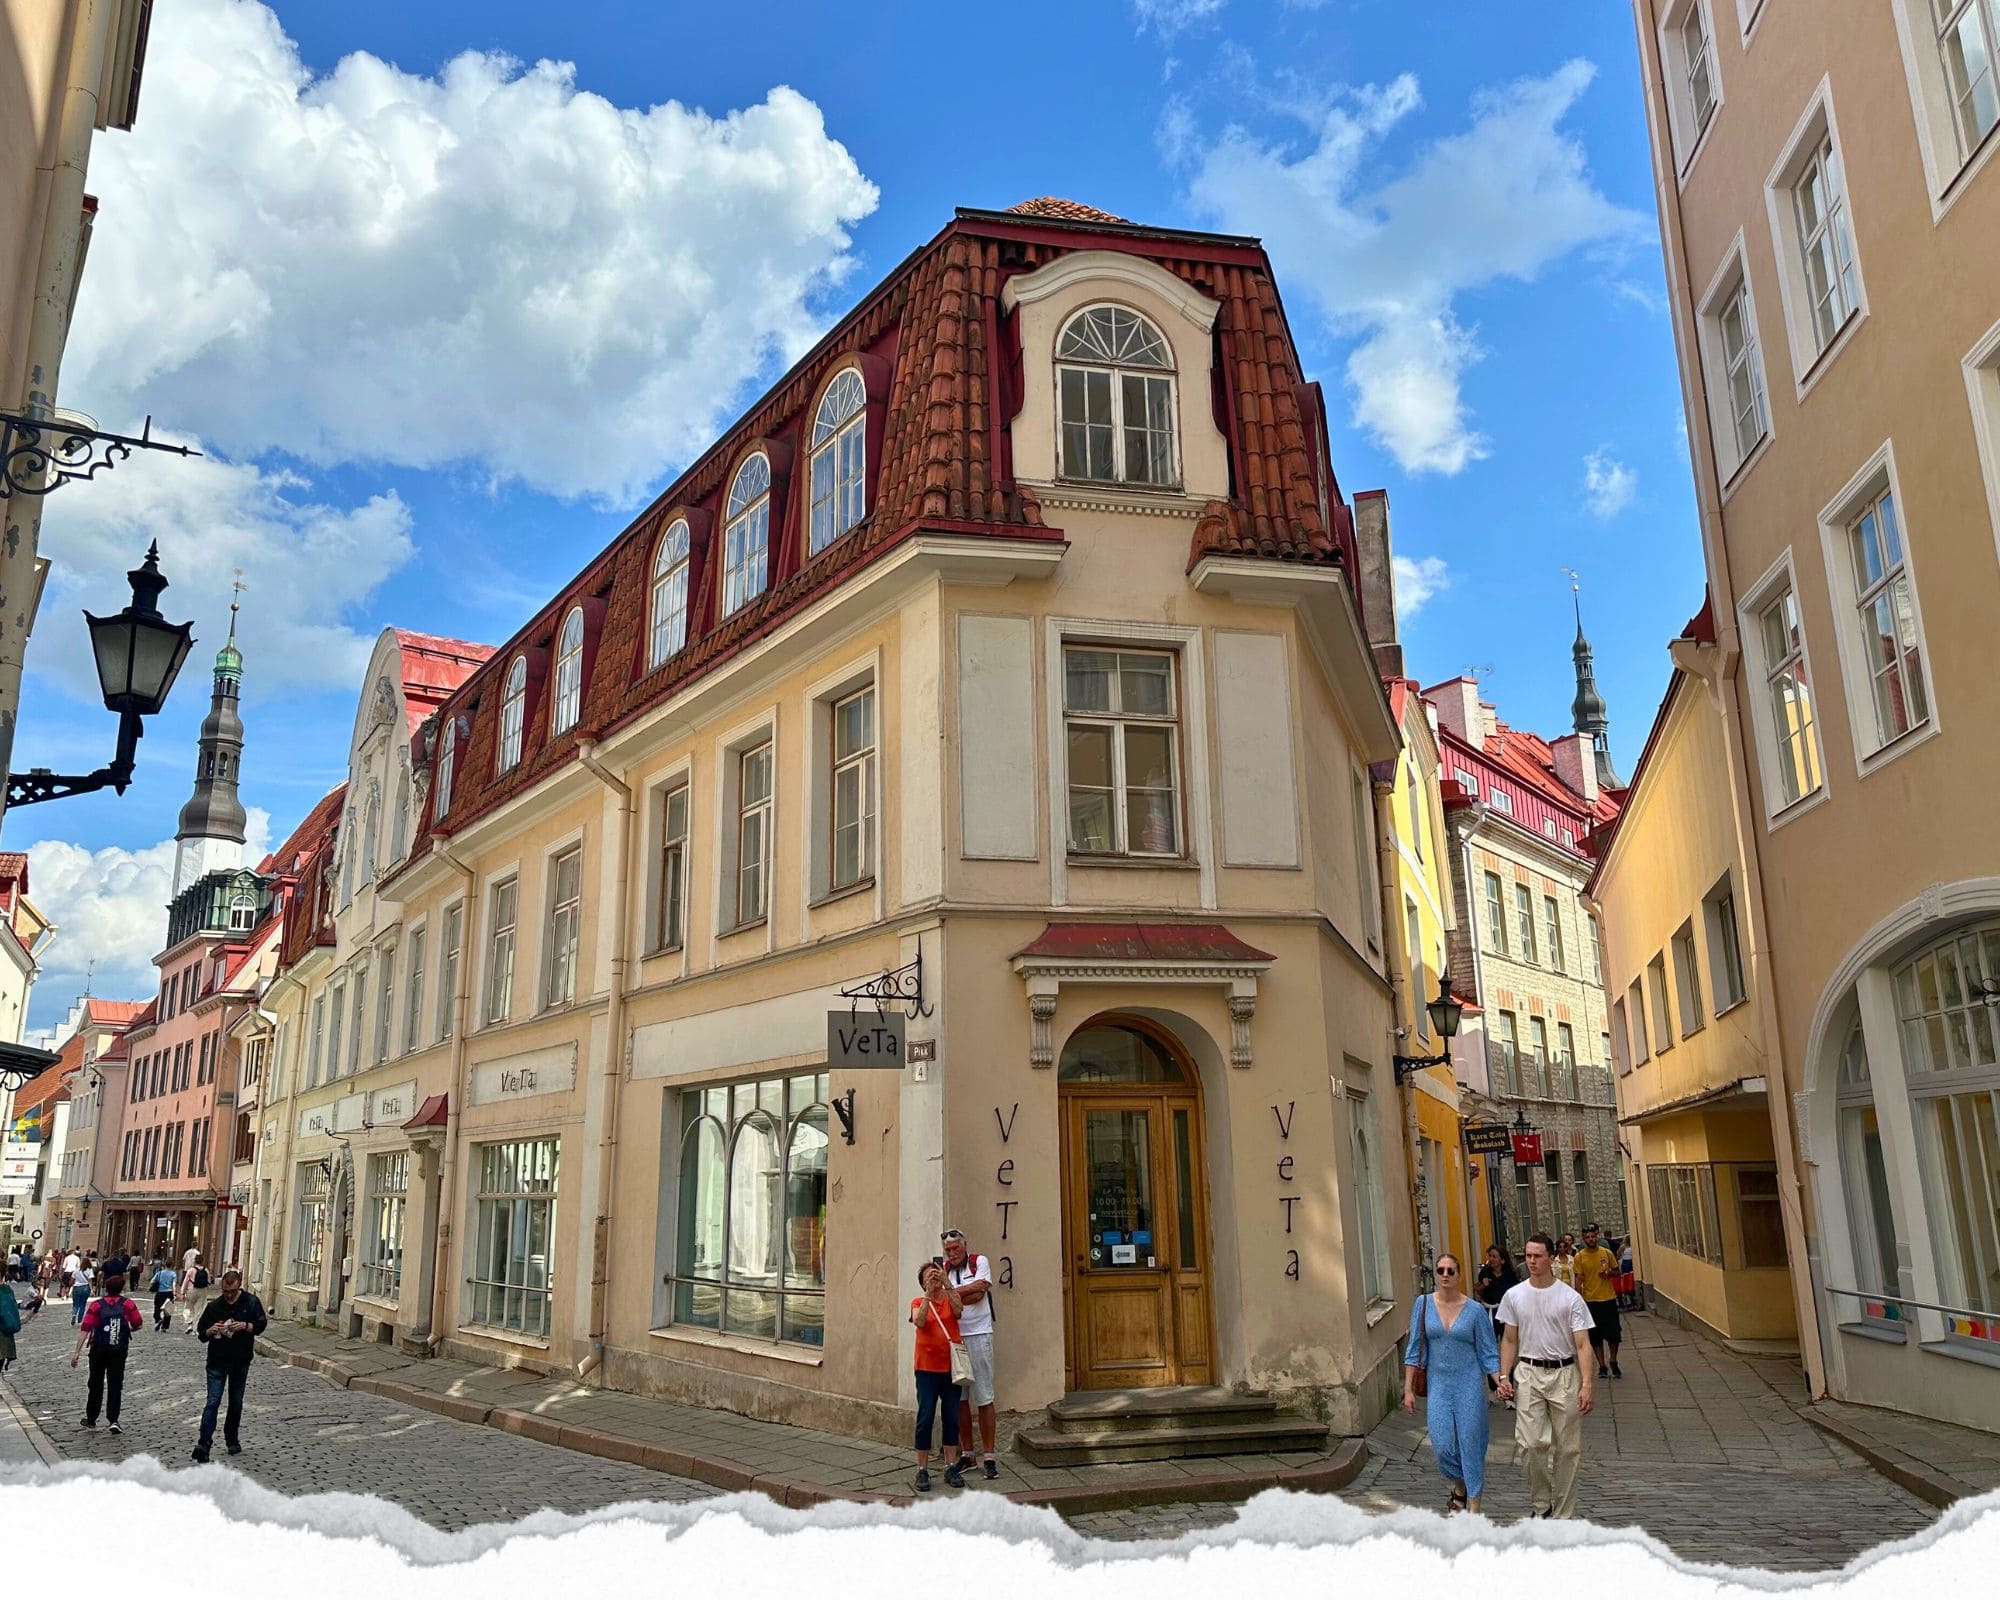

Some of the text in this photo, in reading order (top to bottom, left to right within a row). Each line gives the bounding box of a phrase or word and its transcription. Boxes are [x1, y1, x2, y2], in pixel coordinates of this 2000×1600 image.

[838, 1028, 898, 1056] VeTa
[914, 1047, 929, 1057] Pikk
[501, 1068, 537, 1092] VeTa
[232, 1191, 250, 1204] VeT
